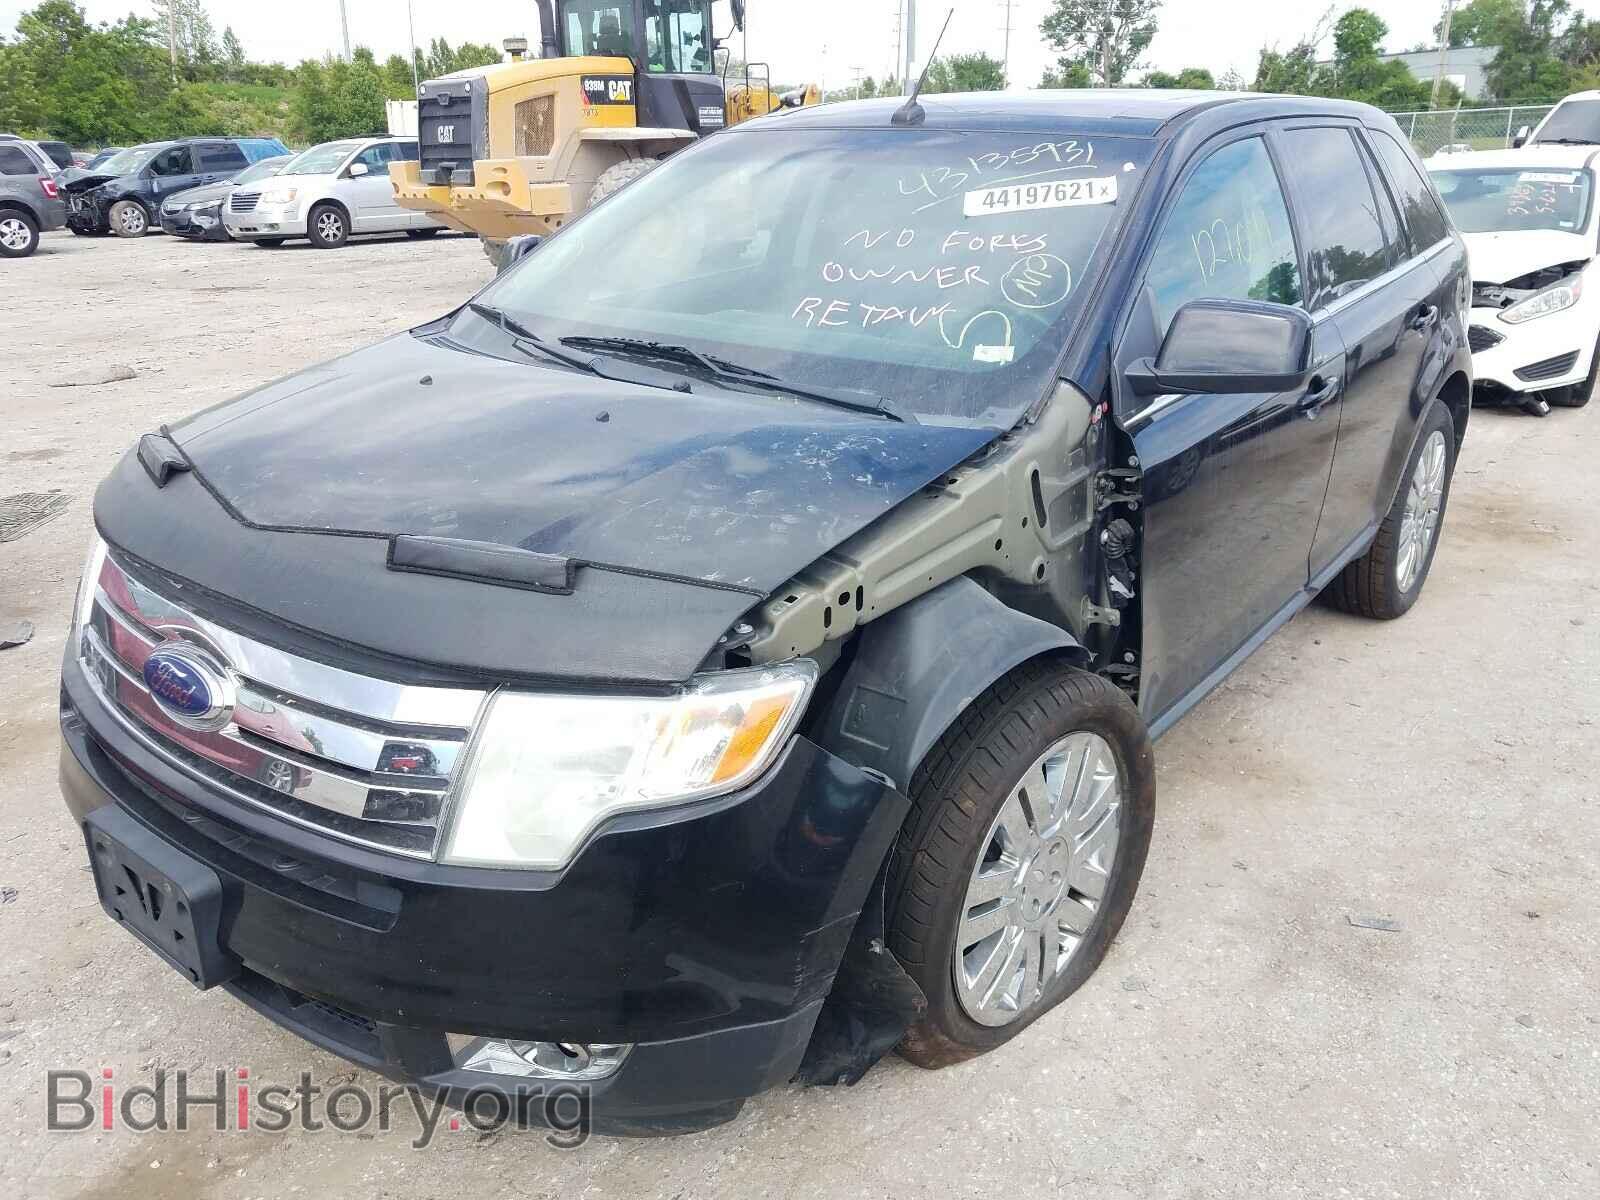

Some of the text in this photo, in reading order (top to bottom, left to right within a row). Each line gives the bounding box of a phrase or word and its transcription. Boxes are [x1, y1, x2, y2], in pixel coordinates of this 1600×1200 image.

[608, 79, 632, 101] CAT
[437, 125, 455, 143] CAT
[981, 181, 1095, 209] 44197621
[844, 228, 1048, 254] NO FORKS
[823, 261, 990, 289] OWNER
[152, 661, 196, 708] Ford
